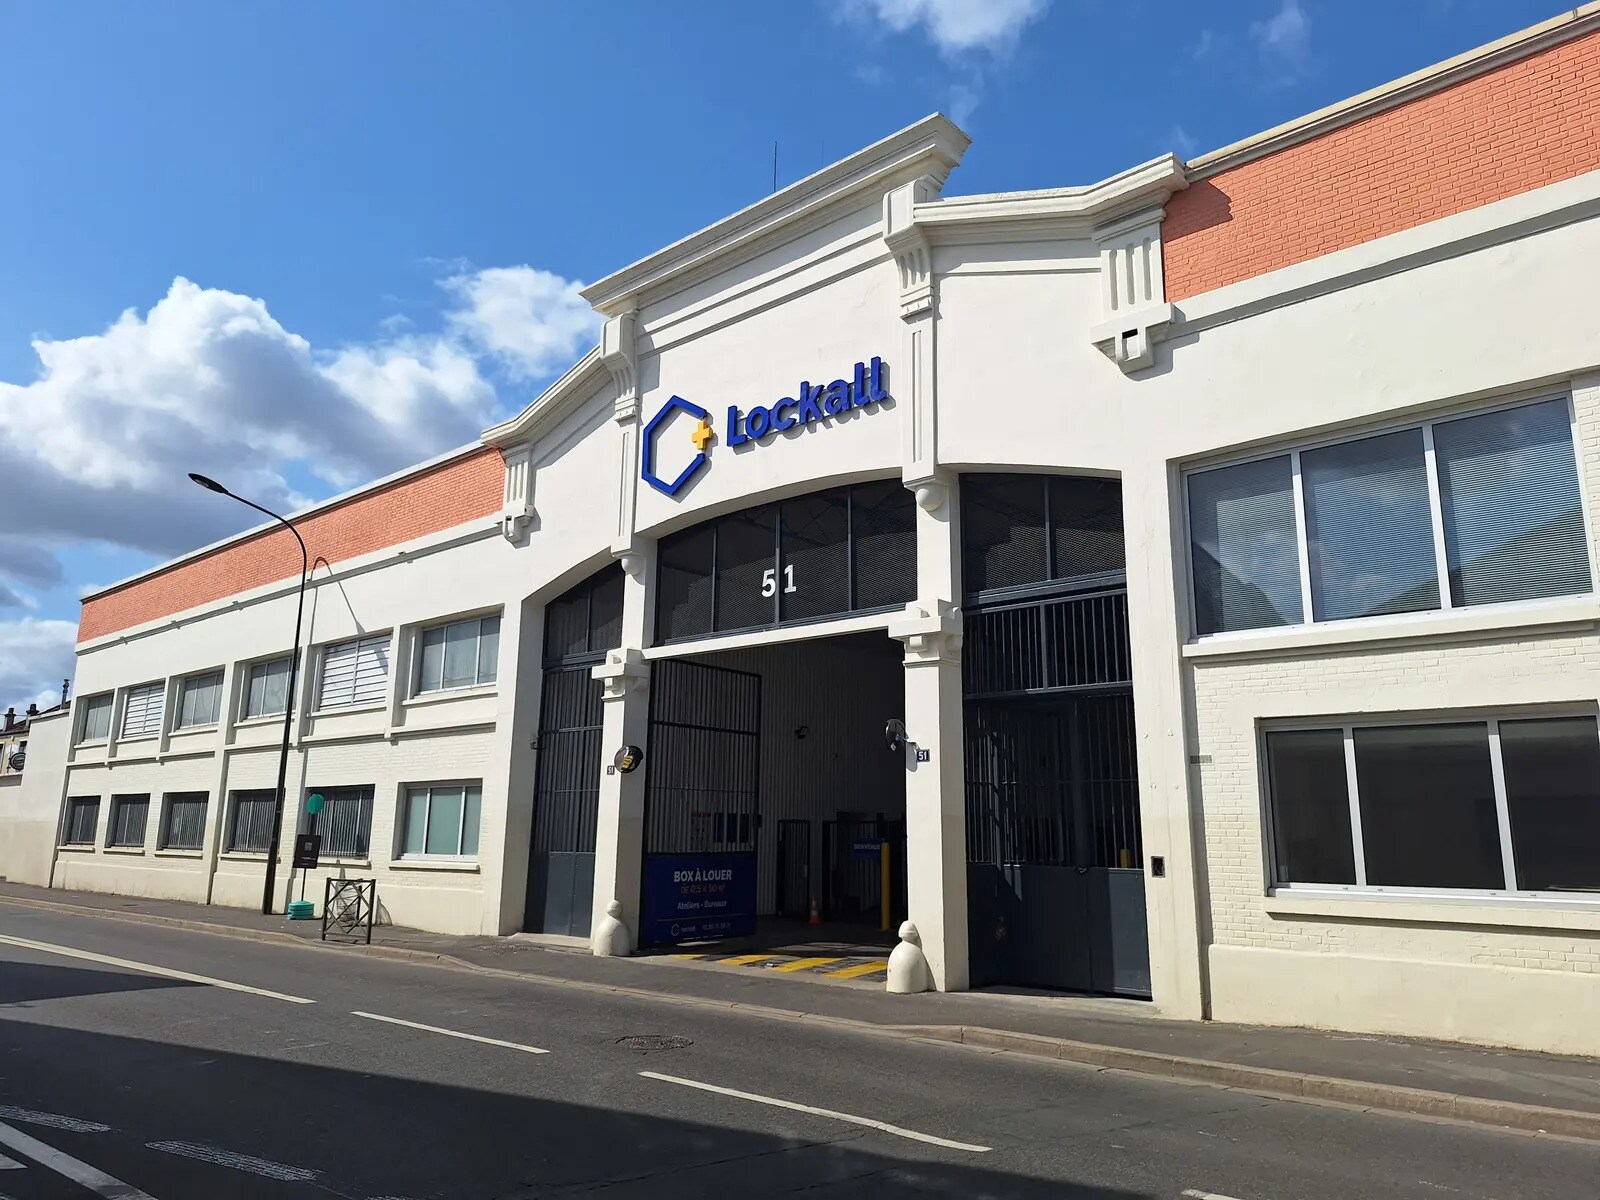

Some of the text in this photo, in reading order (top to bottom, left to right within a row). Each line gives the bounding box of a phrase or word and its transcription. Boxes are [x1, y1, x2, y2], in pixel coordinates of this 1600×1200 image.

[726, 356, 889, 447] Lockall
[761, 564, 797, 598] 51
[918, 751, 927, 761] 51
[674, 868, 732, 882] BOX À LOUER
[677, 902, 700, 910] Ateliers
